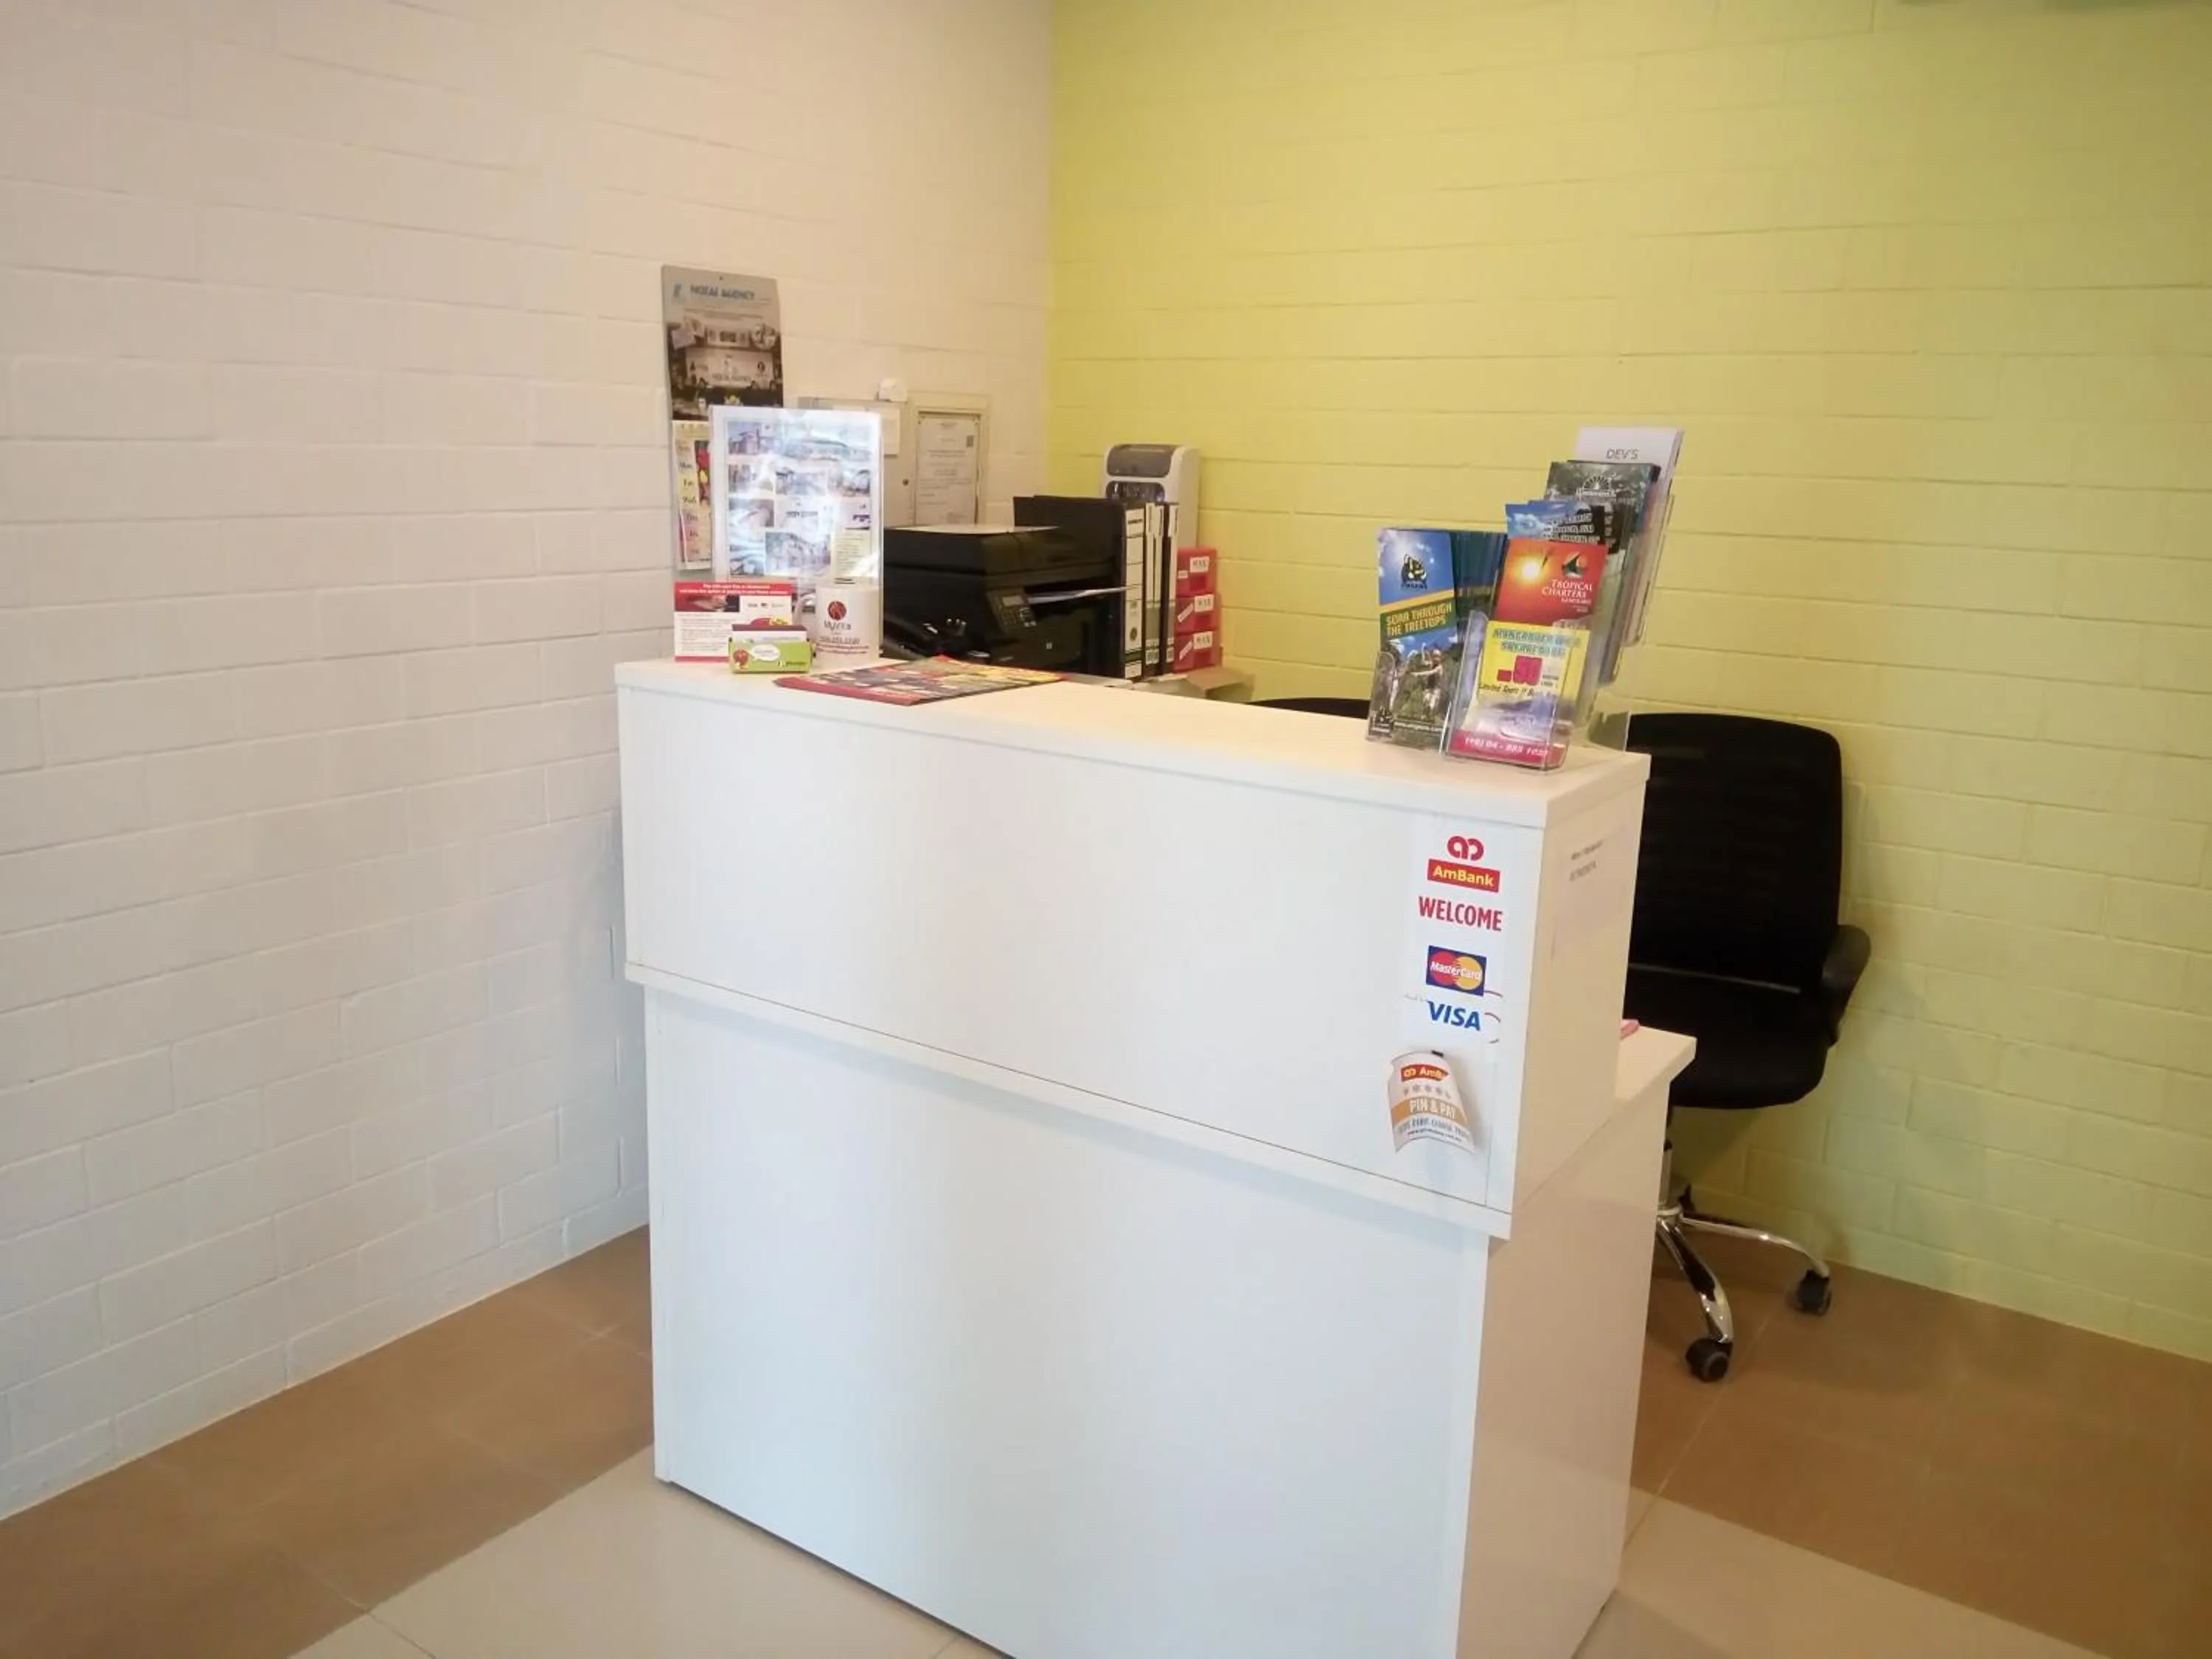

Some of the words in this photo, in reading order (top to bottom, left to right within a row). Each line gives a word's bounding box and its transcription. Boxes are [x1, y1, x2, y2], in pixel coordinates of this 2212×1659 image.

[1606, 448, 1639, 459] DEV'S
[1542, 586, 1587, 598] CHARTERS
[1551, 579, 1593, 592] TROPICAL
[1387, 611, 1409, 624] SOAR
[1411, 602, 1452, 619] THROUGH
[1387, 624, 1402, 637] THE
[1404, 616, 1446, 633] TREETOPS
[1433, 866, 1495, 886] AmBank
[1418, 896, 1503, 932] WELCOME
[1430, 960, 1483, 981] MasterCard
[1427, 1001, 1481, 1032] VISA
[1409, 1097, 1429, 1113] PIN
[1440, 1102, 1457, 1119] PAY
